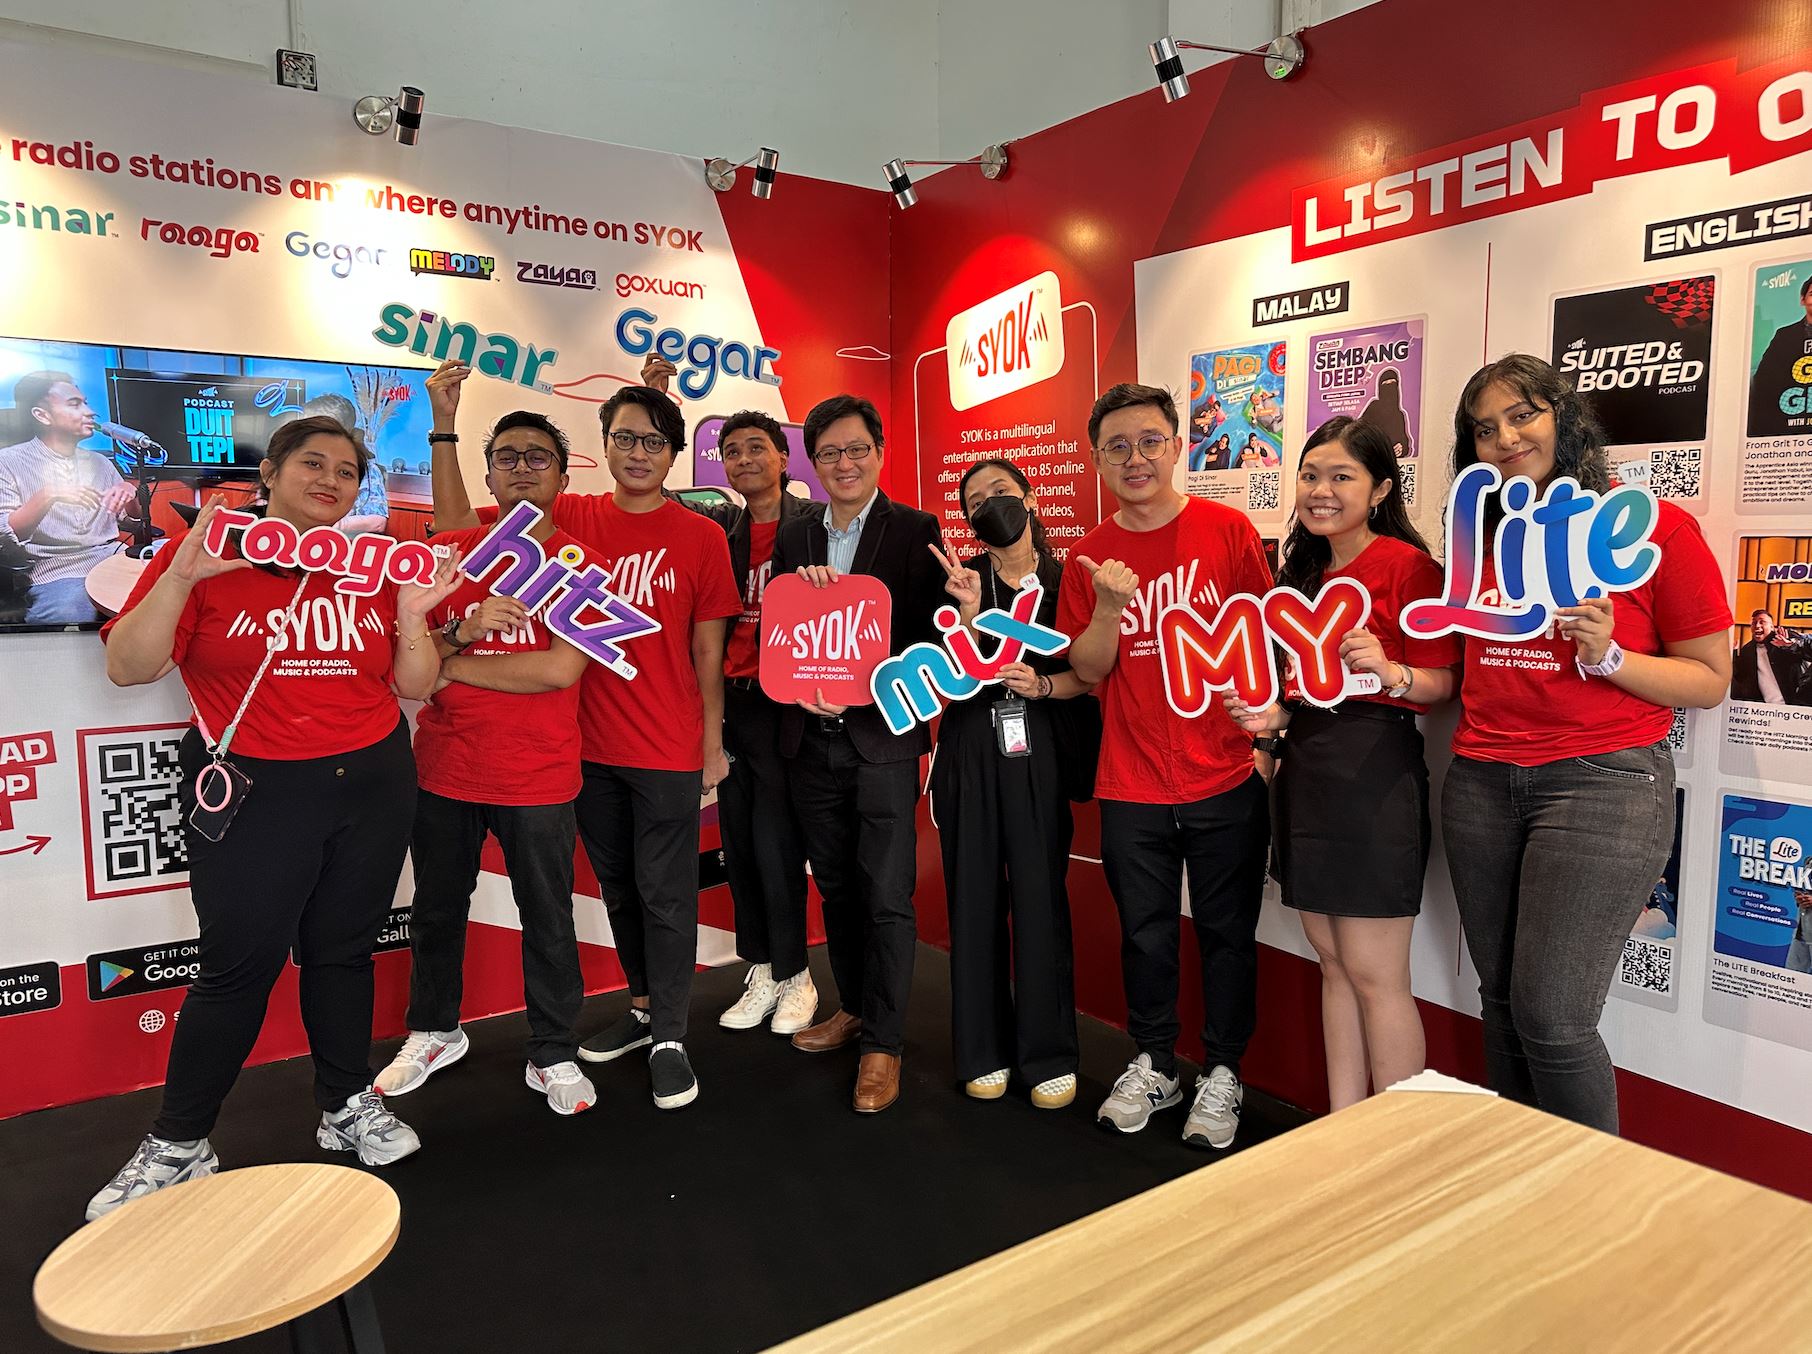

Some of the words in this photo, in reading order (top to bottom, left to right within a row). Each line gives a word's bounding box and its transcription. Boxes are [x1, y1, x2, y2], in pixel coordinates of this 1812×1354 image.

[1306, 128, 1563, 247] LISTEN
[1601, 84, 1716, 161] TO
[12, 139, 120, 173] radio
[129, 155, 281, 195] stations
[290, 178, 457, 219] anwhere
[464, 202, 587, 234] anytime
[594, 220, 628, 243] on
[634, 222, 704, 253] SYOK
[285, 231, 387, 278] Gegar
[410, 248, 495, 275] MELODY
[616, 273, 705, 300] goxuan
[1256, 287, 1341, 323] MALAY
[378, 303, 557, 388] sinar
[977, 291, 1033, 378] SYOK
[616, 310, 779, 398] Gegar
[1315, 341, 1409, 370] SEMBANG
[1560, 341, 1666, 373] SUITED
[1667, 341, 1683, 360] &
[1213, 356, 1262, 380] PAGI
[1321, 367, 1366, 388] DEEP
[1576, 360, 1704, 393] BOOTED
[1658, 384, 1696, 395] PODCAST
[184, 398, 234, 408] PODCAST
[184, 407, 234, 436] DUIT
[961, 428, 984, 444] SYOK
[985, 429, 992, 441] is
[993, 430, 999, 440] a
[1000, 420, 1056, 439] multilingual
[1788, 418, 1804, 426] WITH
[187, 436, 235, 463] TEPI
[943, 448, 1003, 464] entertainment
[1004, 442, 1055, 462] application
[1057, 440, 1078, 454] that
[1744, 451, 1791, 460] Jonathan
[1745, 441, 1770, 449] From
[1773, 439, 1790, 448] Grit
[1792, 439, 1804, 447] To
[938, 470, 960, 483] offers
[1028, 464, 1038, 477] to
[1039, 463, 1051, 477] 85
[1053, 461, 1085, 475] online
[944, 488, 960, 502] radi
[1035, 481, 1076, 498] channel,
[1040, 503, 1075, 518] videos,
[1406, 469, 1655, 634] Lite
[1624, 466, 1645, 478] TM
[461, 503, 658, 665] hitz
[266, 594, 365, 652] SYOK
[792, 600, 865, 660] SYOK
[1129, 649, 1151, 657] MUSIC
[1161, 581, 1367, 714] MY
[1357, 679, 1374, 688] TM
[1486, 646, 1510, 657] HOME
[1511, 648, 1523, 657] OF
[1523, 649, 1555, 660] RADIO,
[281, 659, 309, 667] HOME
[309, 659, 321, 667] OF
[322, 659, 351, 668] RADIO,
[311, 668, 358, 676] PODCASTS
[798, 665, 821, 673] HOME
[832, 666, 849, 674] RADIO,
[874, 588, 1068, 732] mix
[1480, 657, 1505, 667] MUSIC
[1505, 658, 1512, 667] &
[1512, 659, 1561, 671] PODCASTS
[1729, 706, 1749, 715] HITZ
[1751, 708, 1790, 720] Morning
[1729, 715, 1771, 727] Rewinds!
[1729, 834, 1766, 858] THE
[1773, 841, 1799, 858] Lite
[1747, 890, 1763, 900] Lives
[1745, 910, 1791, 926] Conversations
[1759, 902, 1782, 913] People
[144, 951, 166, 962] GET
[168, 949, 178, 959] IT
[180, 945, 199, 956] ON
[19, 974, 39, 984] the
[1713, 958, 1730, 968] The
[1731, 962, 1748, 972] LITE
[1750, 967, 1796, 984] Breakfast
